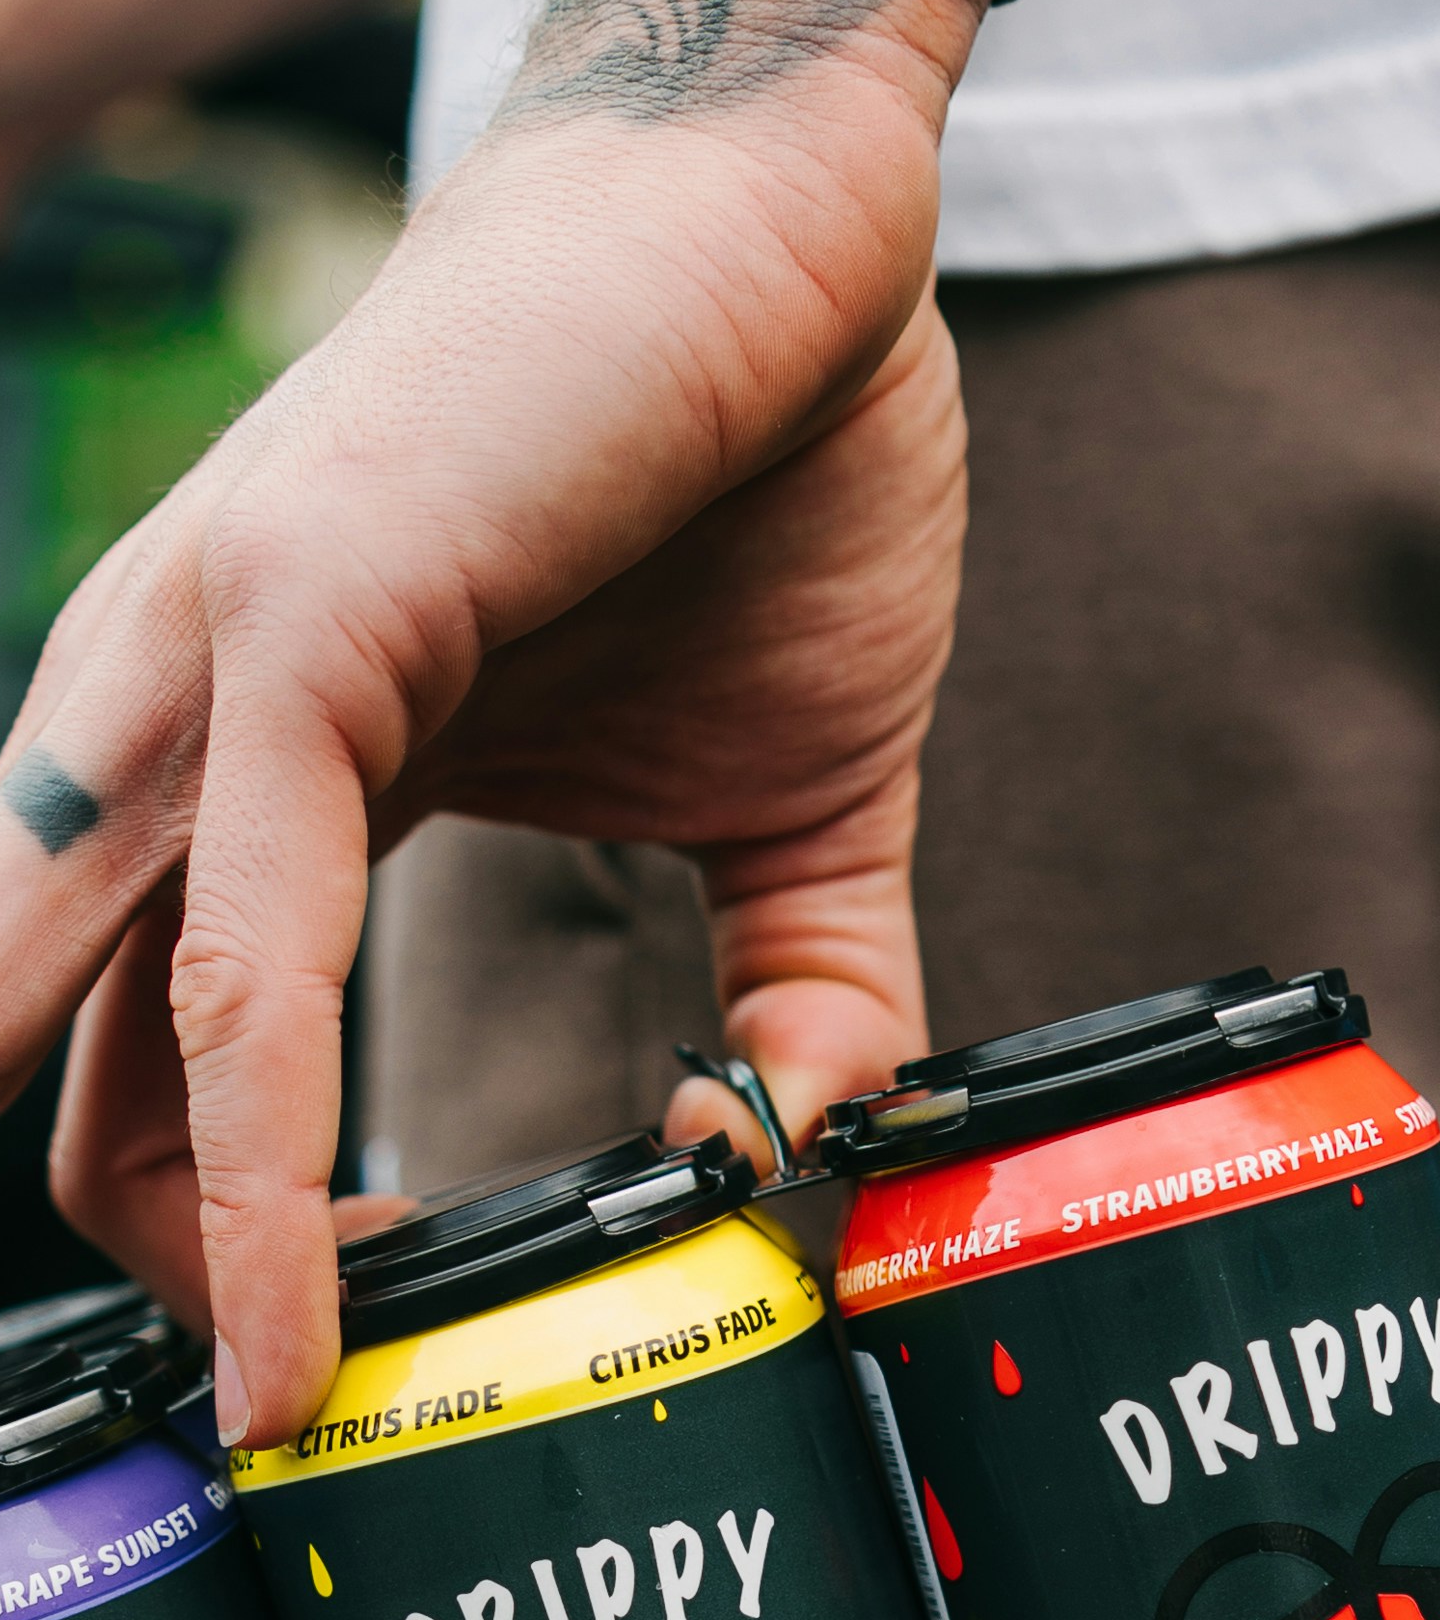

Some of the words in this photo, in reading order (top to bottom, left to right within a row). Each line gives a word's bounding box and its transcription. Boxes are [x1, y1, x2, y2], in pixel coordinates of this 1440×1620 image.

[1061, 1142, 1301, 1233] STRAWBERRY
[1310, 1119, 1382, 1162] HAZE
[943, 1218, 1022, 1266] HAZE
[590, 1325, 710, 1383] CITRUS
[715, 1298, 776, 1344] FADE
[297, 1408, 402, 1460] CITRUS
[415, 1383, 502, 1430] FADE
[99, 1504, 197, 1575] SUNSET
